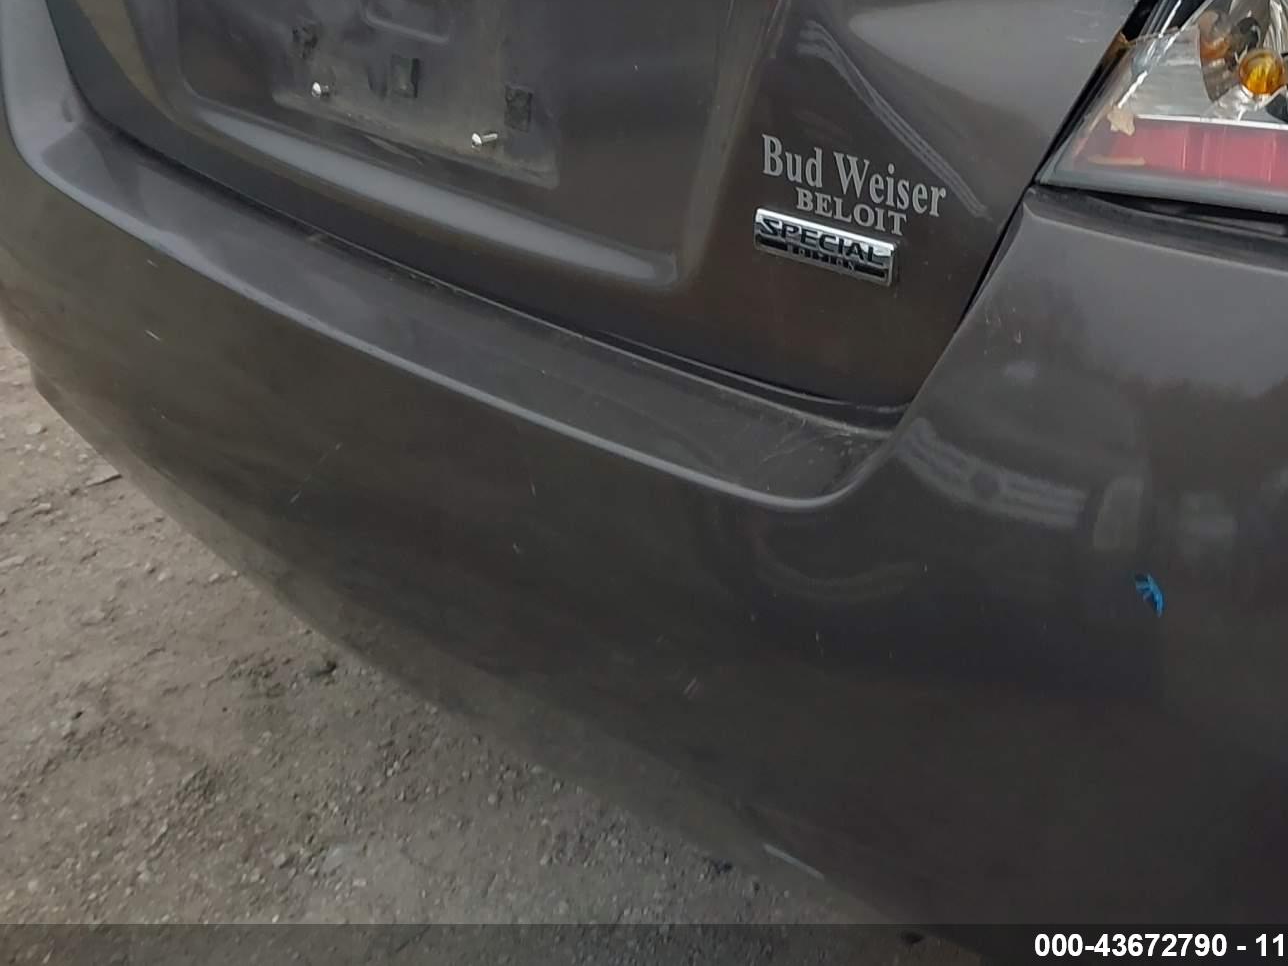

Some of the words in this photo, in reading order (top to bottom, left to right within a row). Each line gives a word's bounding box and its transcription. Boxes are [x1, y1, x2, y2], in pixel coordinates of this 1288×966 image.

[762, 133, 823, 188] Bud
[833, 151, 947, 218] Weiser
[795, 186, 908, 236] BELOIT
[760, 217, 891, 267] SPECIAL
